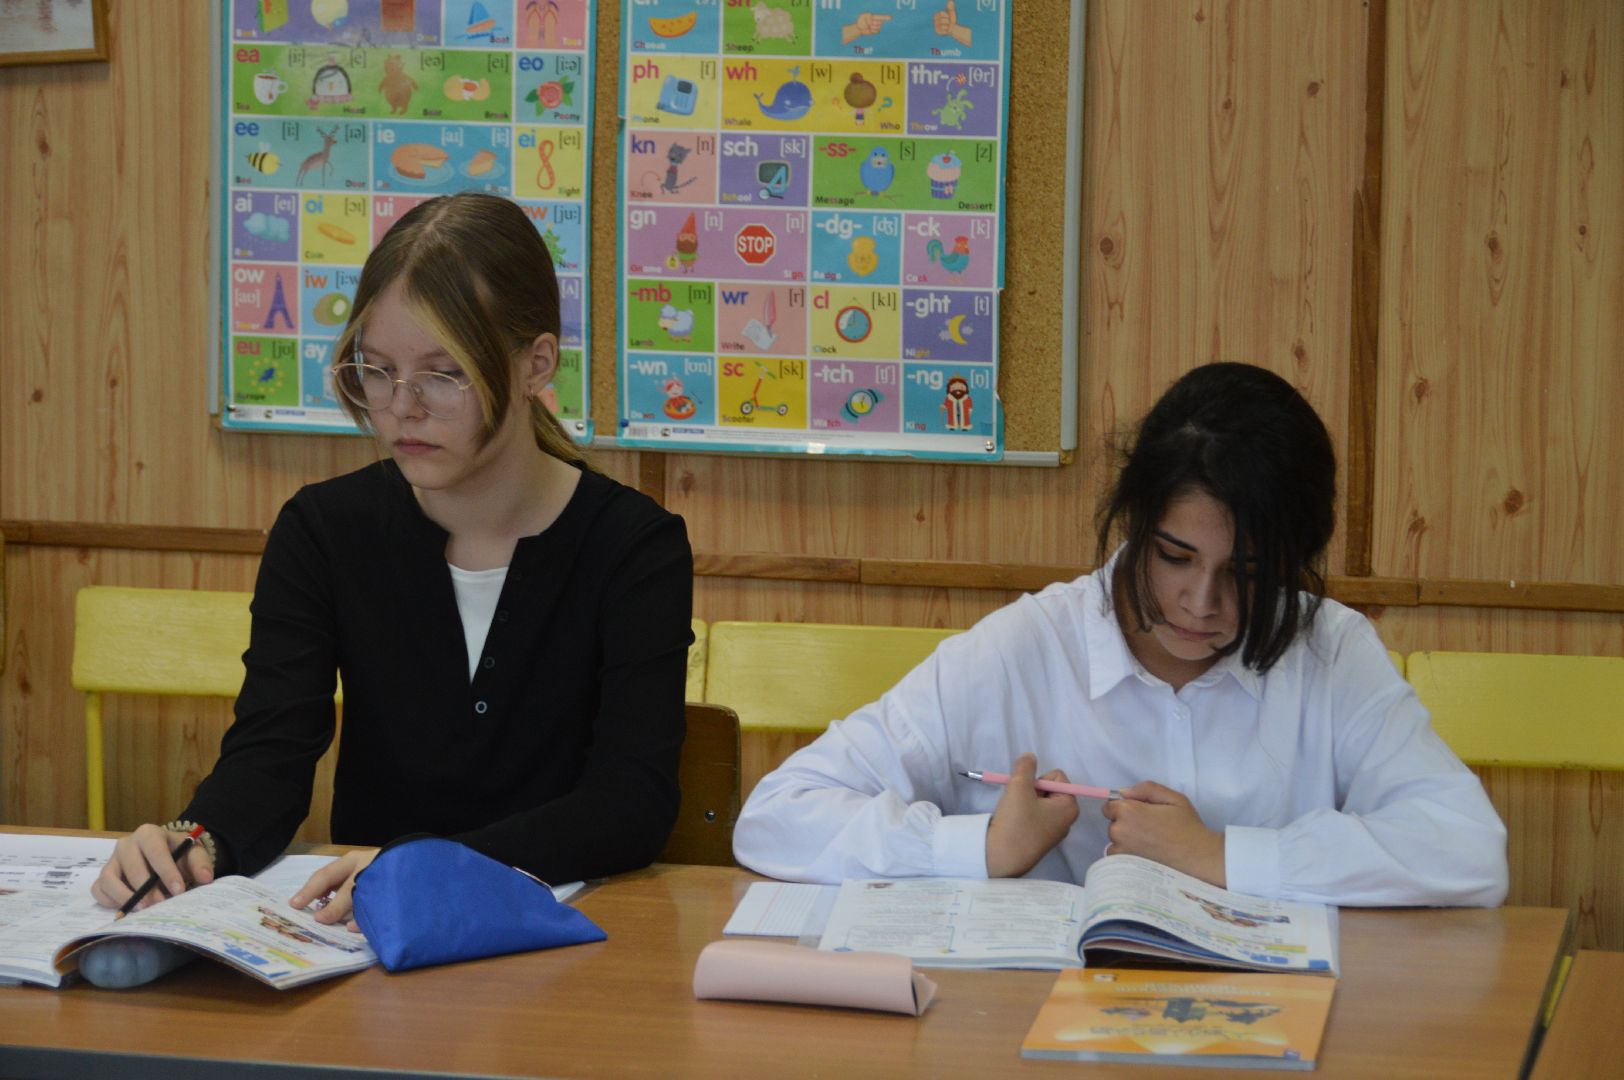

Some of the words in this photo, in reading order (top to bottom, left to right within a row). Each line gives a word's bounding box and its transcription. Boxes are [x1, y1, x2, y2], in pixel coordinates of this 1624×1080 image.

[236, 49, 260, 63] ea
[519, 57, 543, 70] eo
[633, 60, 659, 82] ph
[726, 61, 757, 81] wh
[911, 65, 949, 85] thr-
[235, 122, 259, 136] ee
[378, 125, 395, 143] ie
[880, 122, 901, 130] Who
[518, 129, 536, 147] ei
[631, 135, 656, 154] kn
[723, 136, 758, 156] sch
[818, 143, 857, 158] -ss-
[235, 193, 252, 212] ai
[305, 195, 323, 214] oi
[376, 198, 393, 216] ui
[816, 195, 855, 206] Message
[958, 201, 992, 210] Dessert
[630, 209, 657, 229] gn
[816, 214, 863, 240] -dg-
[908, 217, 941, 237] -ck
[738, 236, 773, 253] STOP
[235, 269, 264, 284] ow
[305, 270, 327, 289] iw
[906, 273, 928, 282] Cock
[630, 283, 672, 303] -mb
[722, 290, 748, 304] wr
[813, 290, 829, 309] cl
[905, 293, 951, 318] -ght
[236, 341, 262, 356] eu
[305, 343, 327, 363] ay
[630, 360, 667, 375] -wn
[723, 362, 744, 377] sc
[814, 364, 853, 384] -tch
[907, 369, 943, 390] -ng
[905, 421, 926, 432] King
